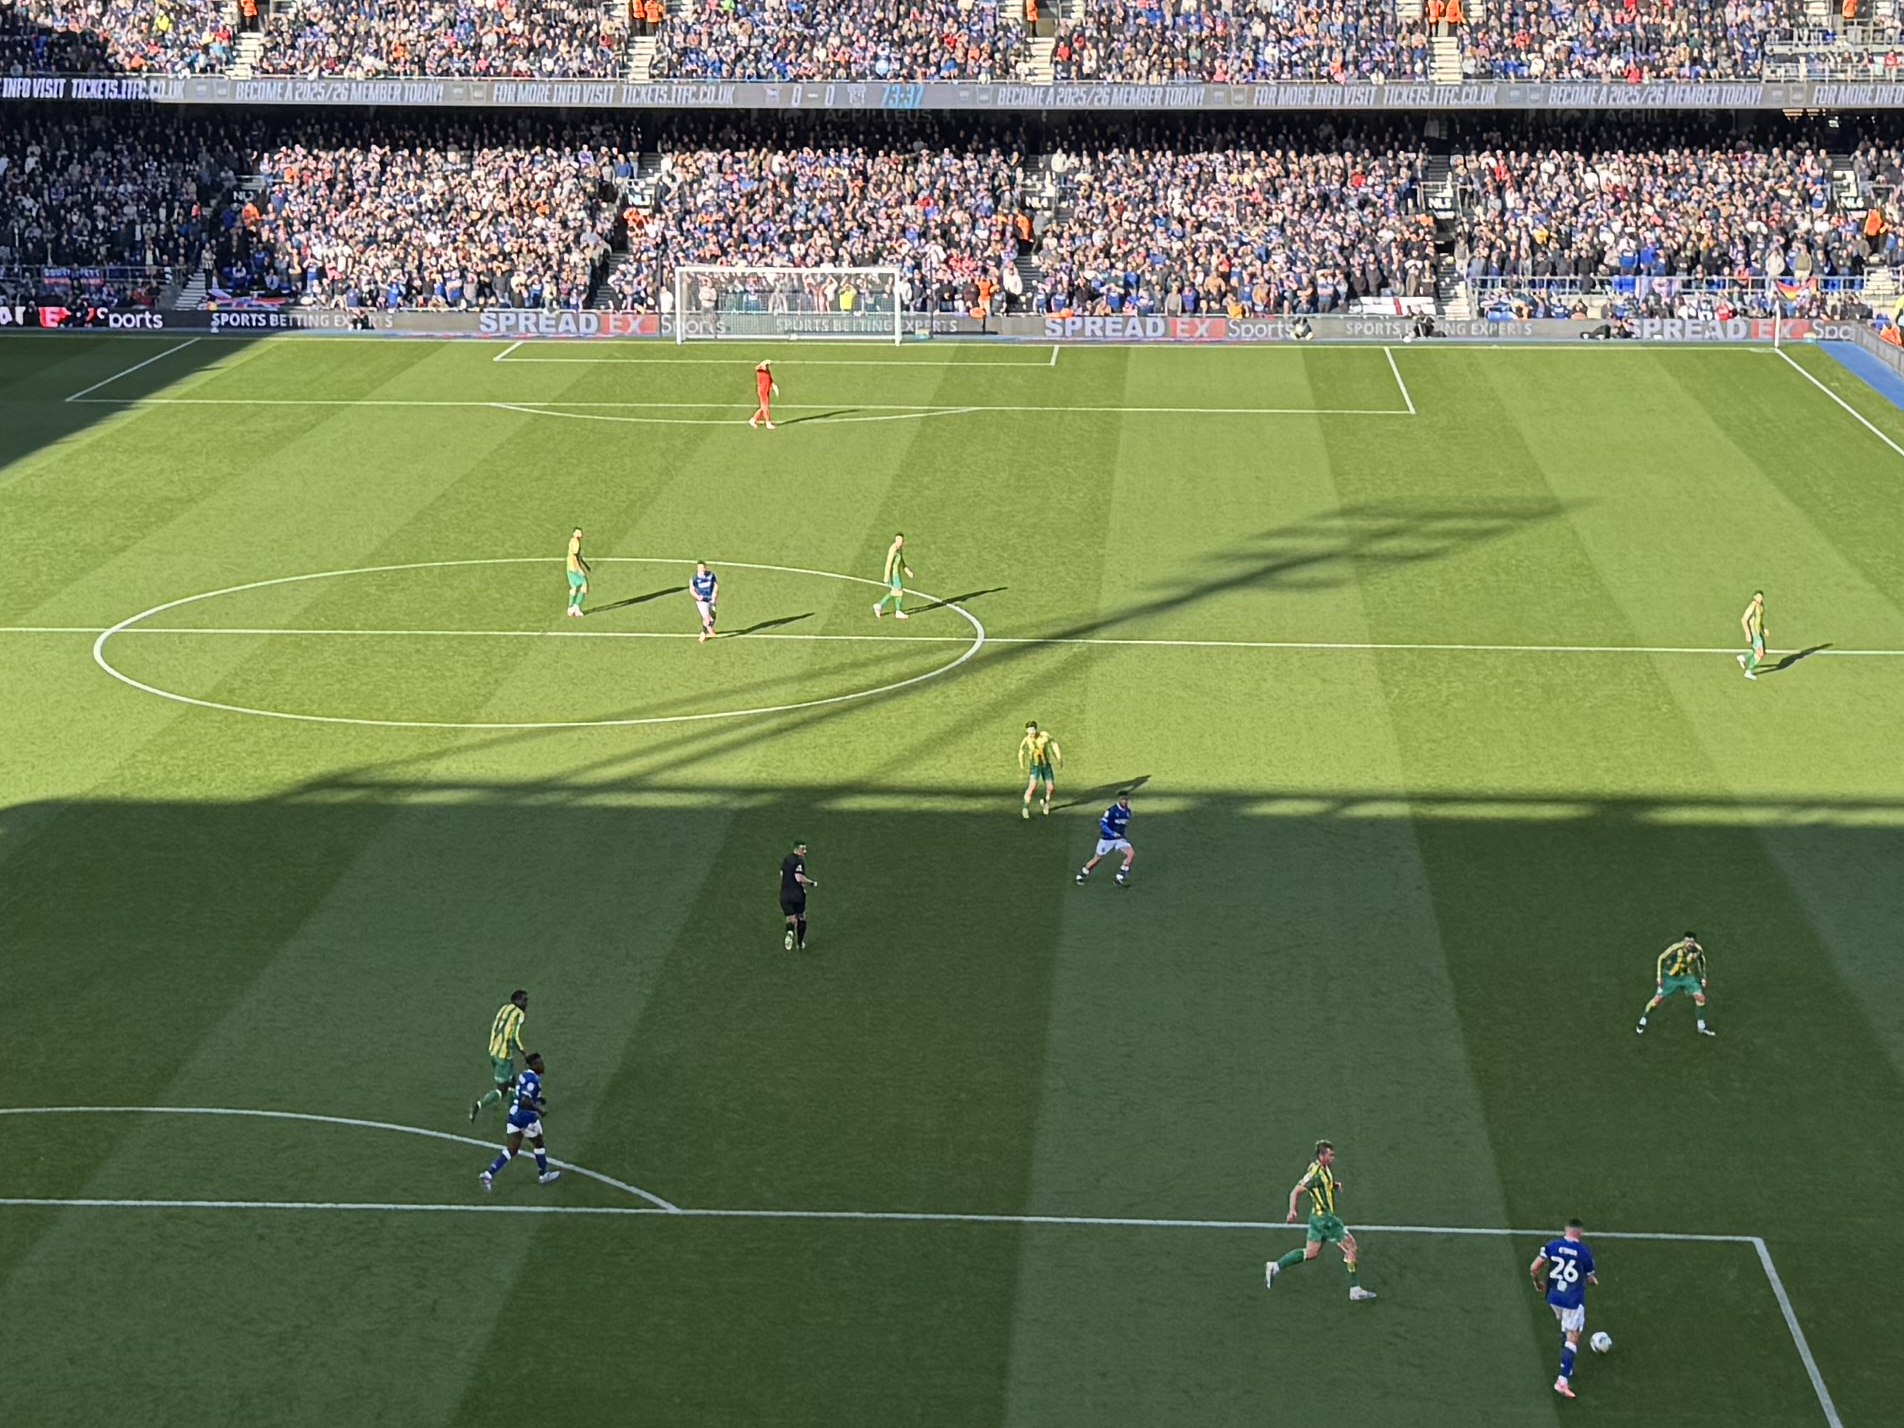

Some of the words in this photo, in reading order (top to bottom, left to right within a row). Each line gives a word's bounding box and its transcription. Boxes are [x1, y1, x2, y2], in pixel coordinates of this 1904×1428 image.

[3, 78, 31, 98] INFO
[33, 79, 66, 99] VISIT
[71, 79, 185, 100] TICKETS.ITFC.CO.UK
[236, 81, 284, 101] BECOME
[284, 82, 293, 101] A
[295, 82, 349, 102] 2025/26
[349, 82, 402, 103] MEMBER
[403, 82, 444, 103] TODAY!
[493, 84, 516, 103] FOR
[517, 84, 551, 104] MORE
[552, 84, 581, 104] INFO
[583, 84, 616, 104] VISIT
[621, 84, 736, 105] TICKETS.ITFC.CO.UK
[791, 84, 802, 107] 0
[824, 84, 836, 107] 0
[881, 83, 925, 108] 73:37
[998, 86, 1045, 106] BECOME
[1045, 87, 1055, 106] A
[1057, 87, 1111, 106] 2025/26
[1111, 87, 1164, 106] MEMBER
[1164, 87, 1205, 106] TODAY!
[1253, 86, 1277, 105] FOR
[1277, 86, 1312, 105] MORE
[1313, 86, 1342, 105] INFO
[1344, 86, 1376, 105] VISIT
[1383, 86, 1498, 106] TICKETS.ITFC.CO.UK
[1549, 84, 1597, 105] BECOME
[1598, 85, 1608, 105] A
[1609, 85, 1665, 105] 2025/26
[1665, 85, 1720, 105] MEMBER
[1720, 85, 1762, 106] TODAY!
[1812, 84, 1838, 105] FOR
[1838, 84, 1874, 105] MORE
[1874, 84, 1904, 104] INFO
[211, 312, 266, 327] SPORTS
[270, 313, 329, 328] BETTING
[479, 314, 599, 334] SPREAD
[608, 315, 645, 333] EX
[1045, 317, 1165, 337] SPREAD
[1176, 318, 1212, 337] EX
[1228, 319, 1293, 340] Sports
[1346, 322, 1399, 338] SPORTS
[1471, 323, 1532, 339] EXPERTS
[1549, 1256, 1579, 1283] 26
